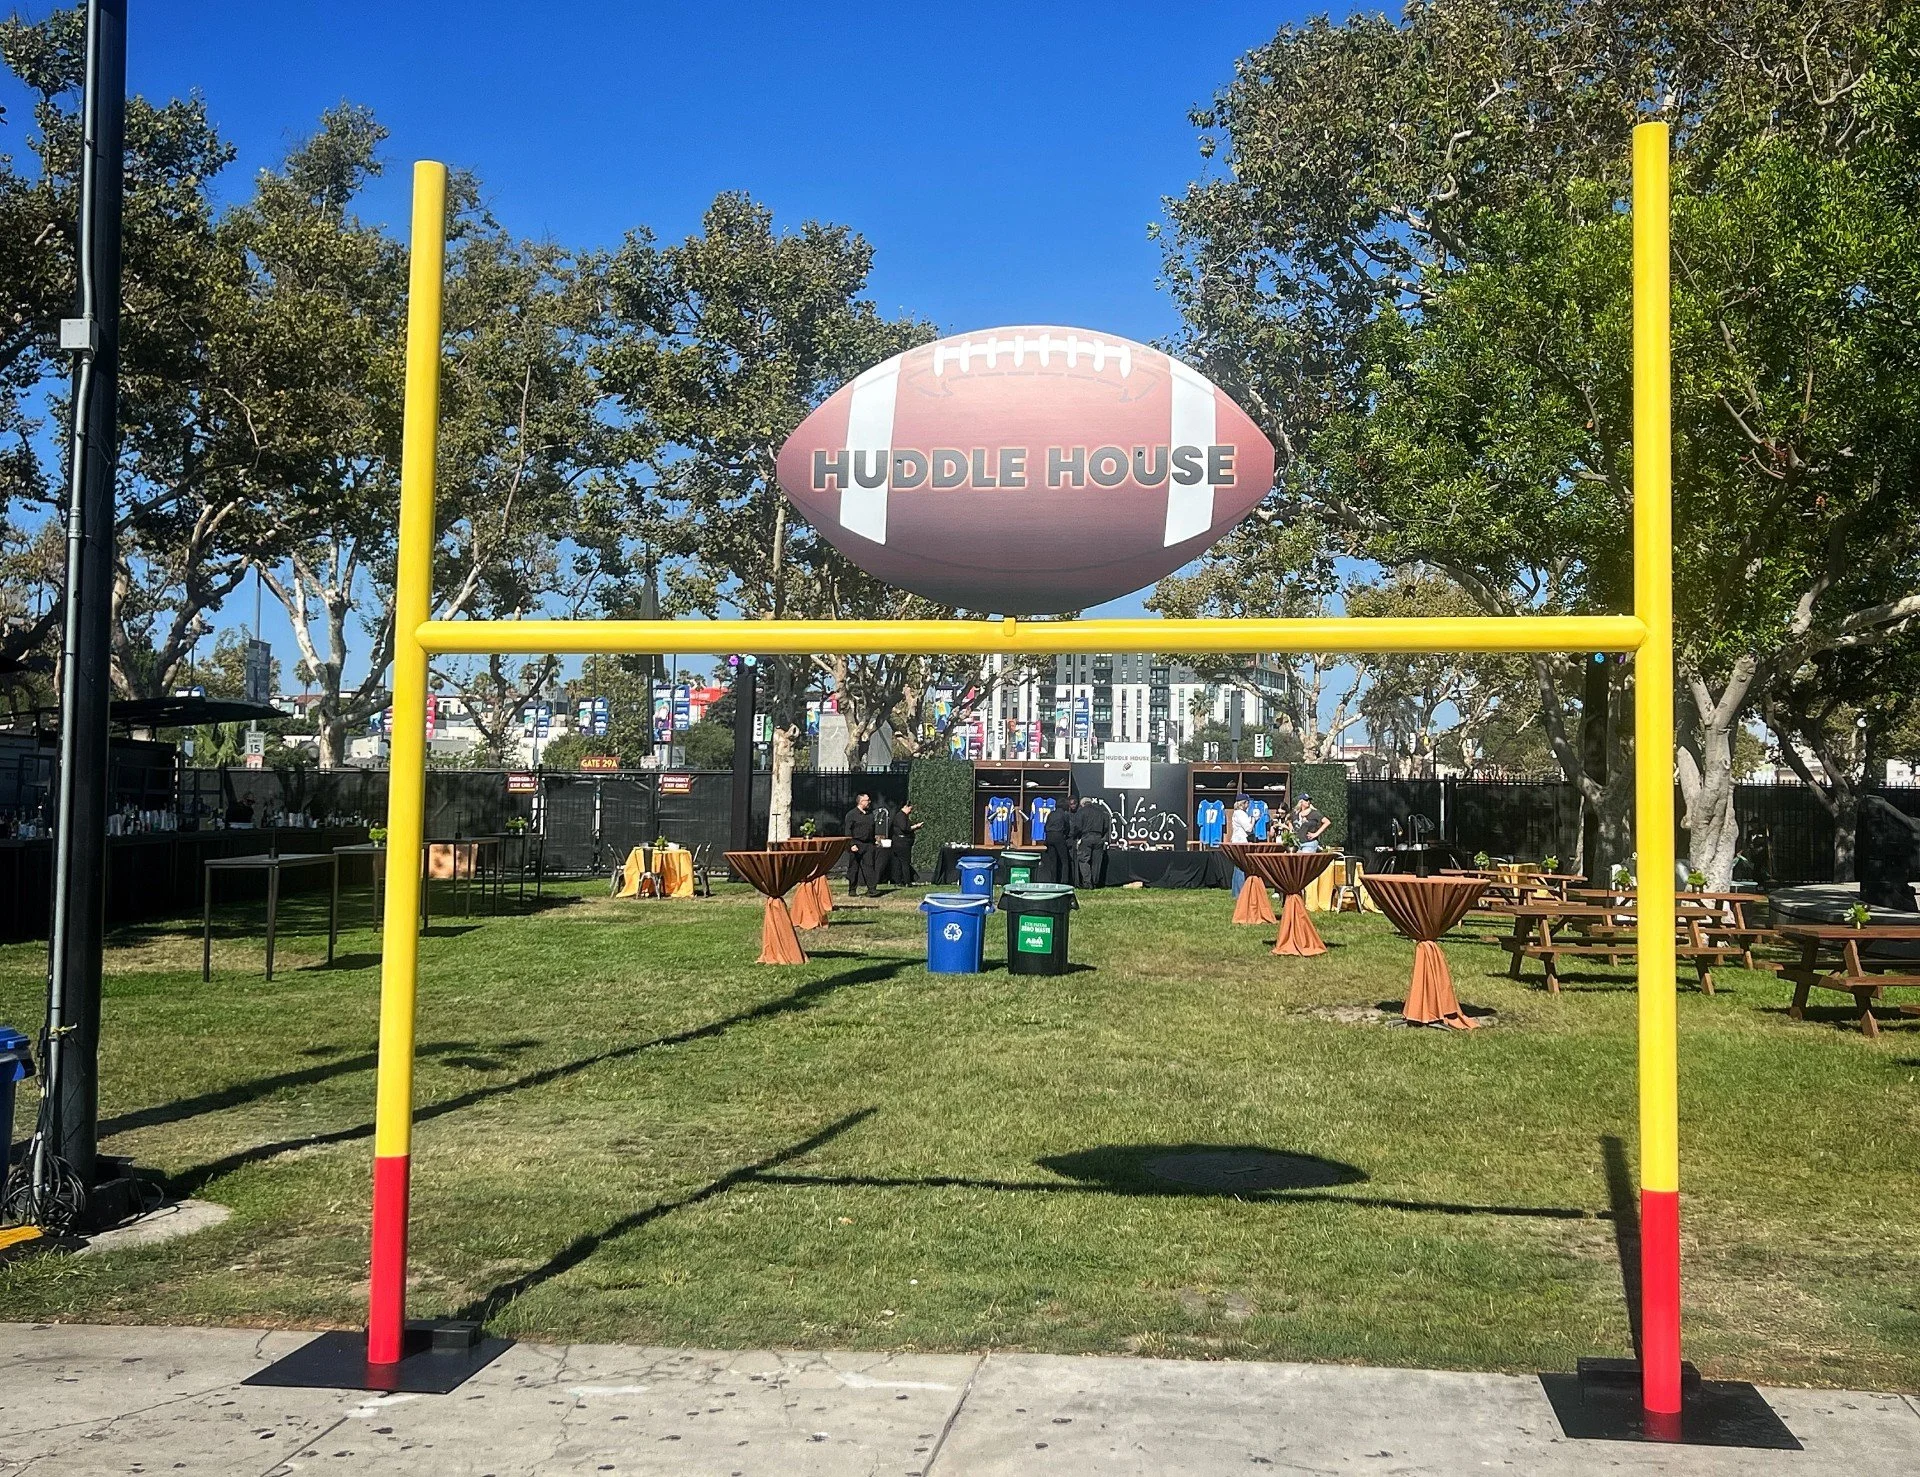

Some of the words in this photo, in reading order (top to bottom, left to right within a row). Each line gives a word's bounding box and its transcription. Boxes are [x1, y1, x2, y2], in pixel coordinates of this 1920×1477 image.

[812, 447, 1028, 490] HUDDLE
[1047, 445, 1236, 488] HOUSE
[250, 744, 261, 753] 15
[581, 758, 600, 768] GATE
[602, 758, 618, 768] 29A
[1038, 807, 1052, 823] 17
